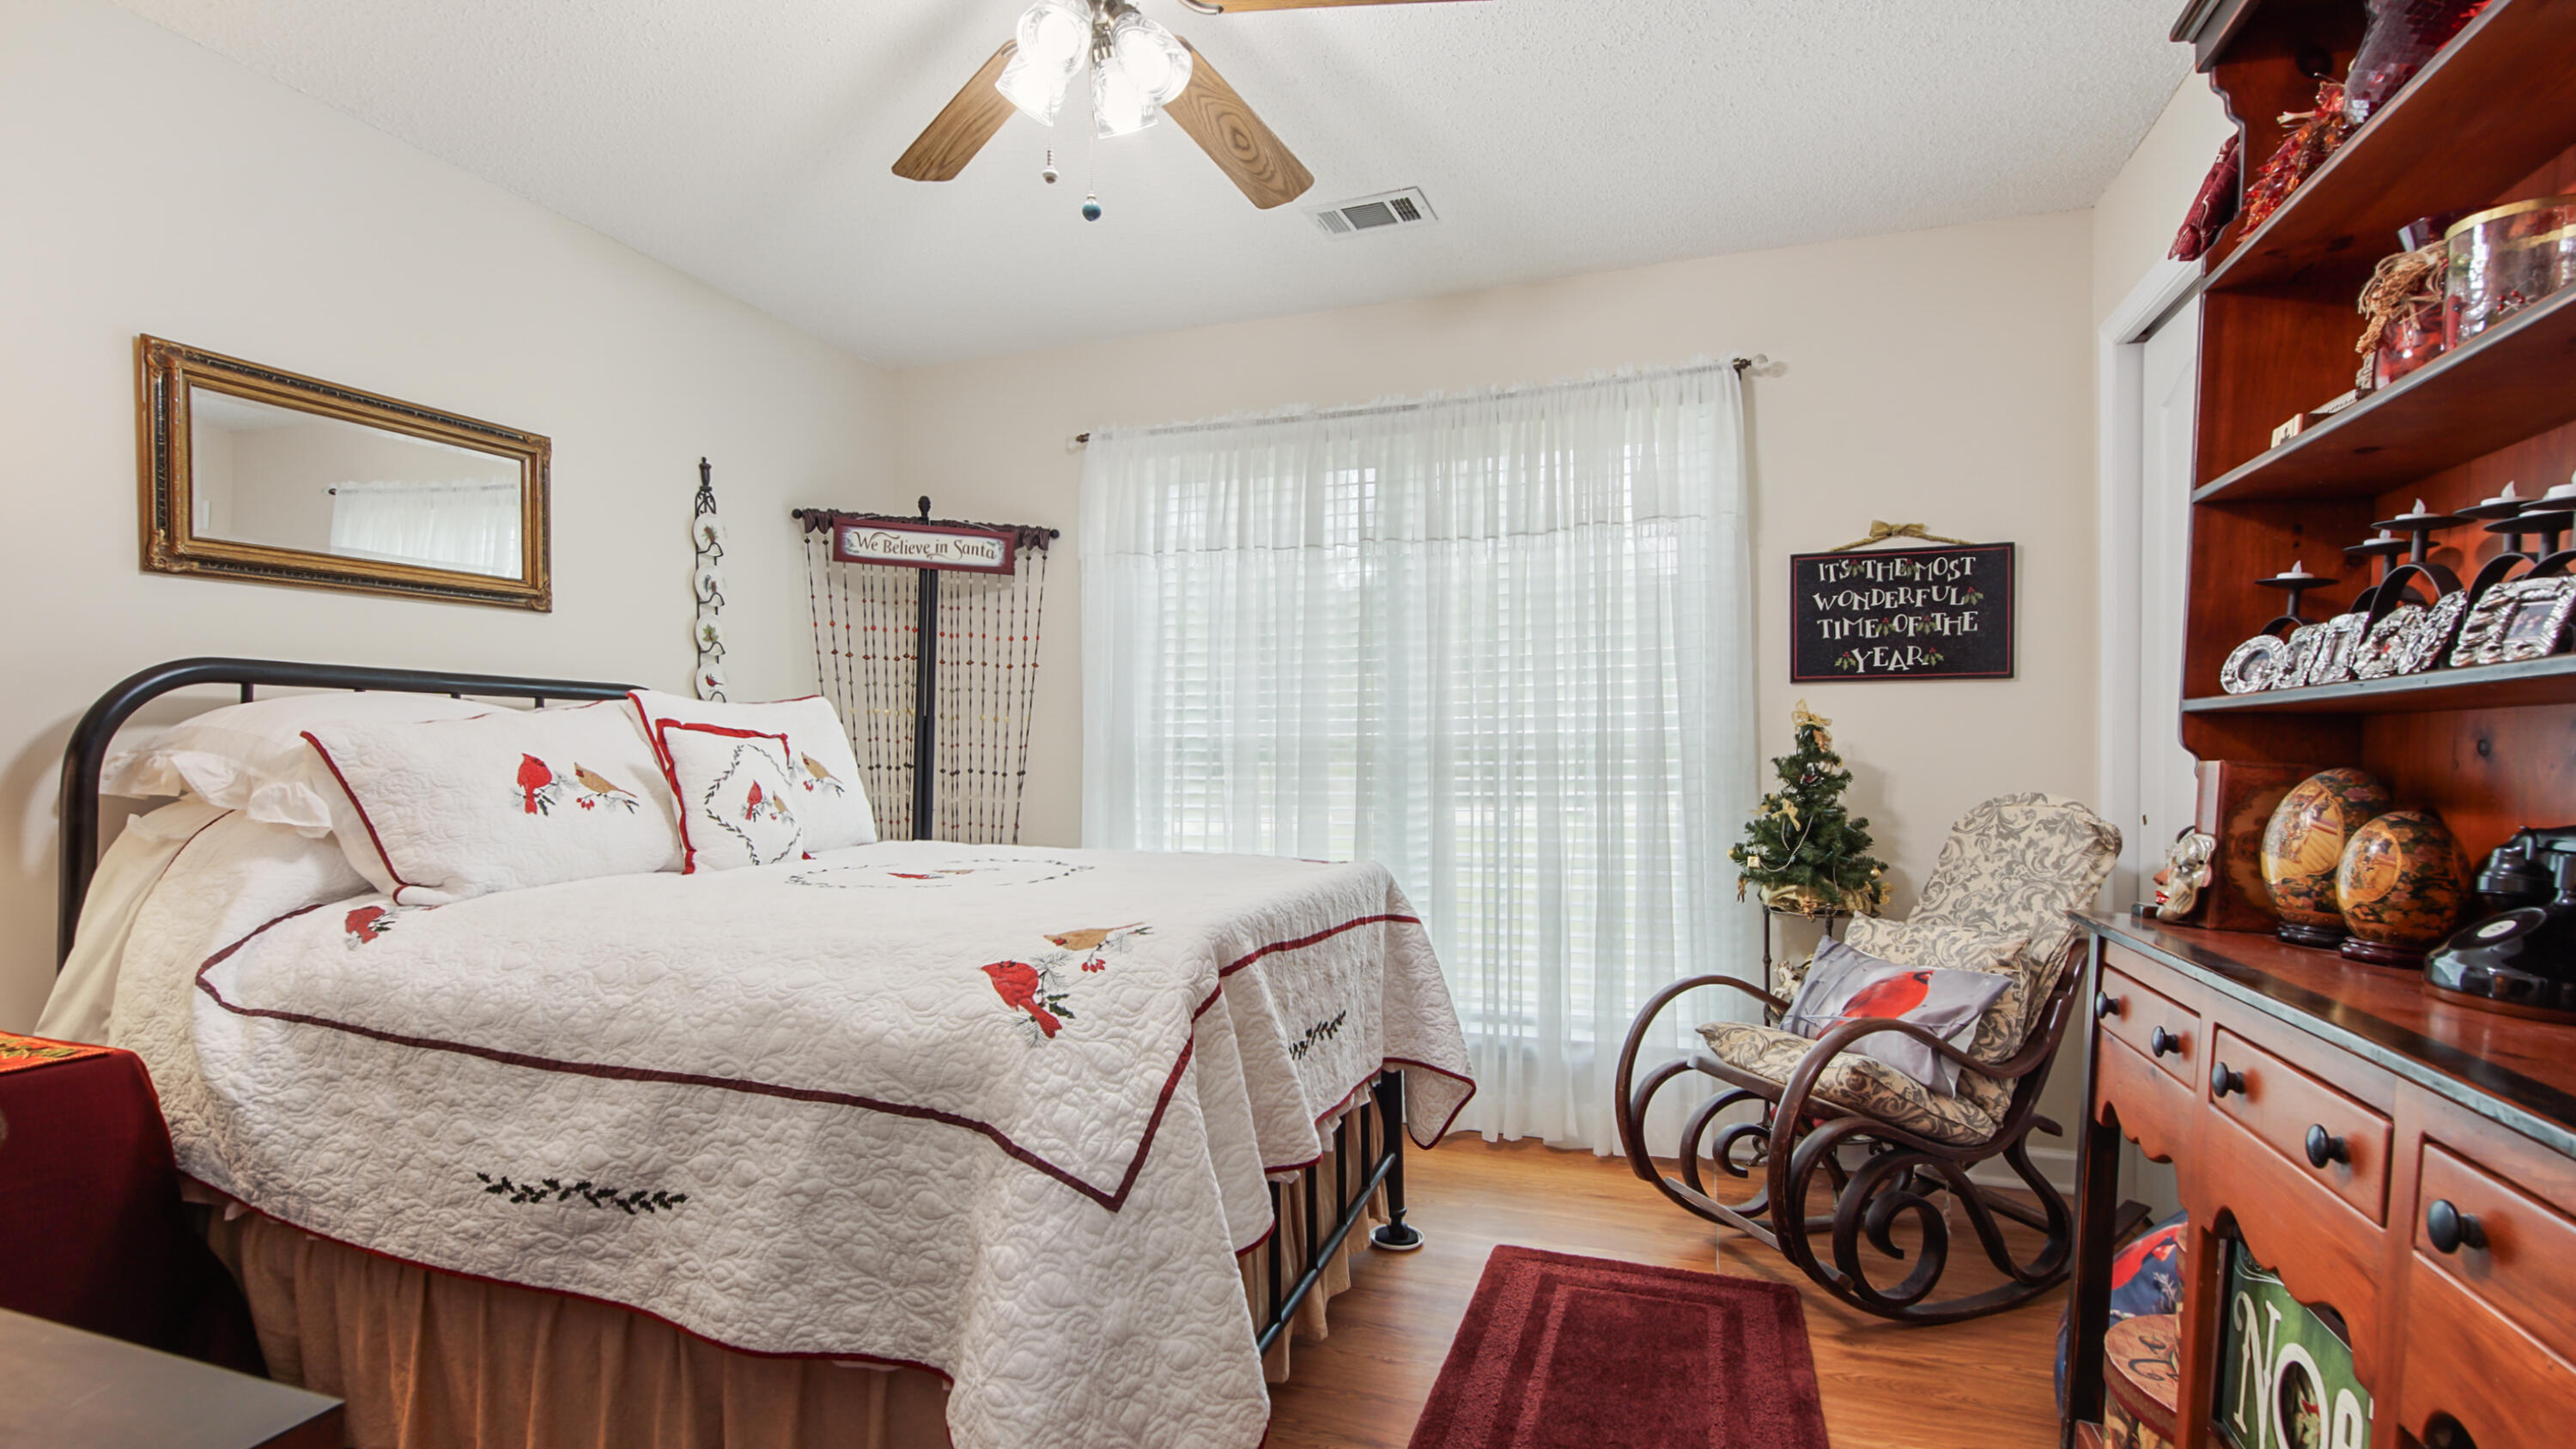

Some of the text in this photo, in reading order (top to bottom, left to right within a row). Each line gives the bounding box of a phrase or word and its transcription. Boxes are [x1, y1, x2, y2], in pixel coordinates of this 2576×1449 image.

[854, 531, 997, 560] We Believe in Santa
[1819, 557, 1976, 582] IT'S THE MOST
[1814, 585, 1965, 610] WONDERFUL
[1817, 611, 1978, 639] TIME OF THE
[1851, 645, 1929, 672] YEAR
